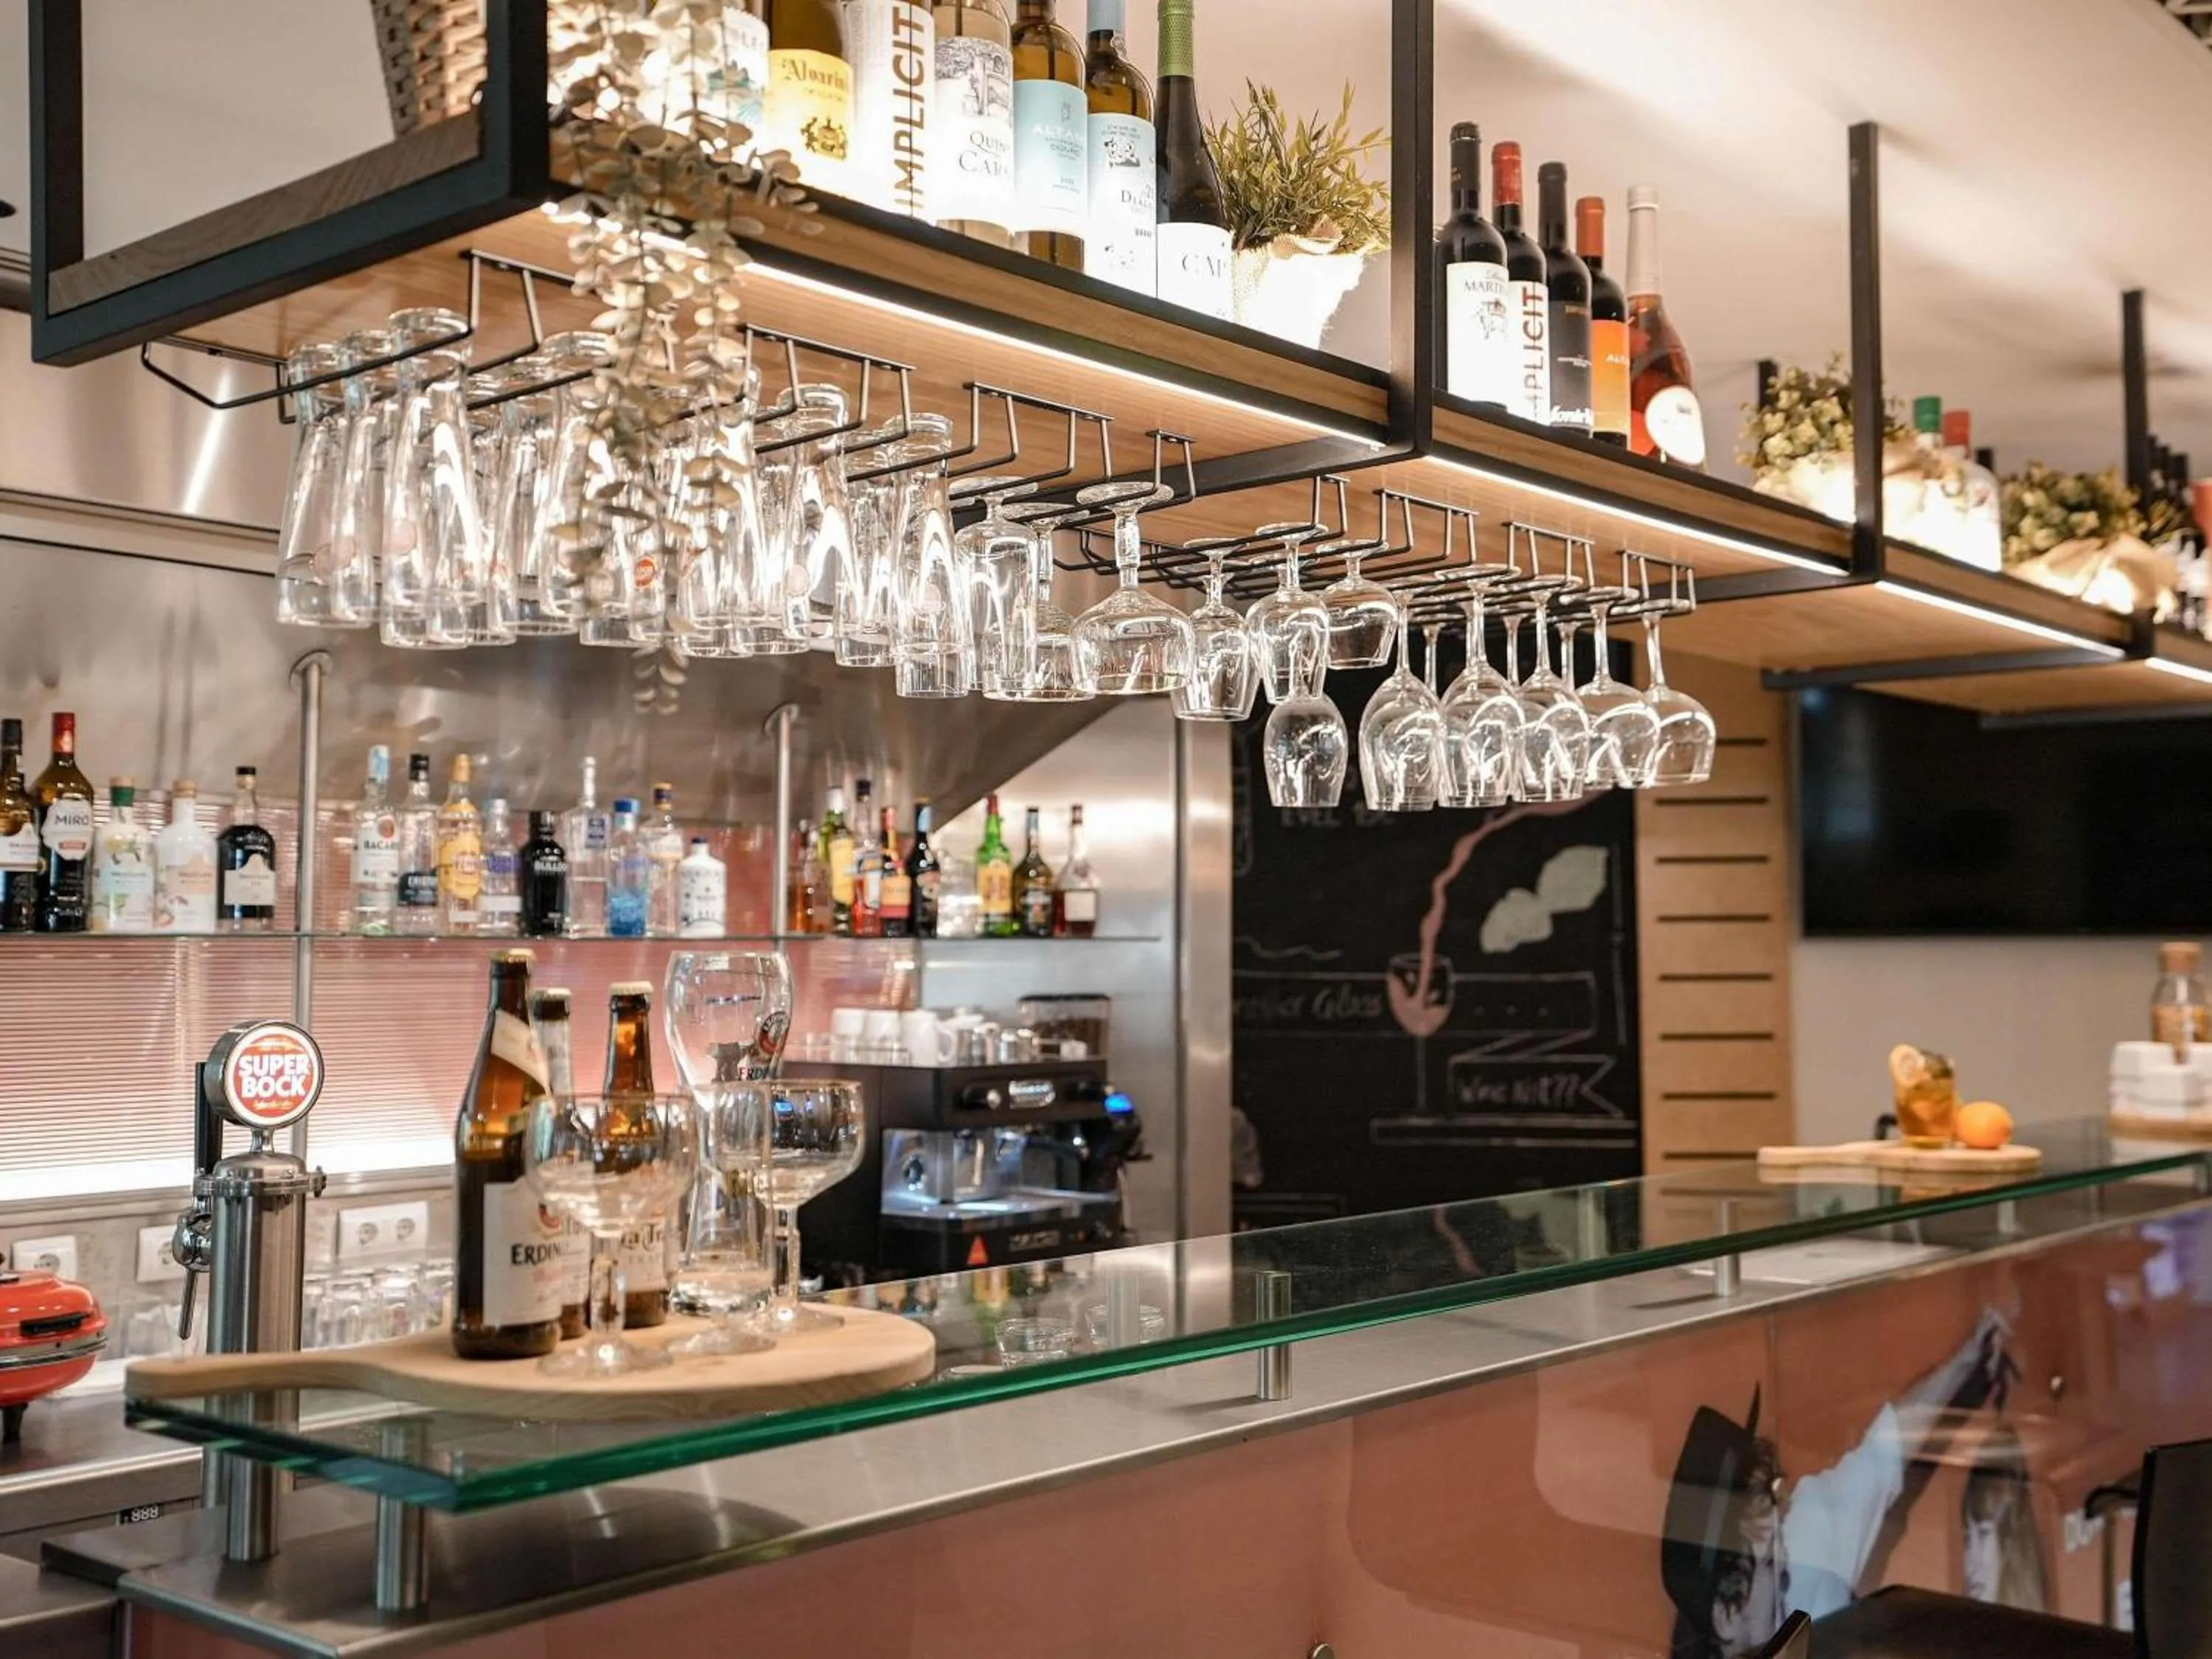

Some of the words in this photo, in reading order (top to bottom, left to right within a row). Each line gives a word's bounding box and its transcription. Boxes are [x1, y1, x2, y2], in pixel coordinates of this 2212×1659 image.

[892, 7, 925, 209] IMPLICIT
[238, 1054, 310, 1077] SUPER
[241, 1075, 307, 1099] BOCK
